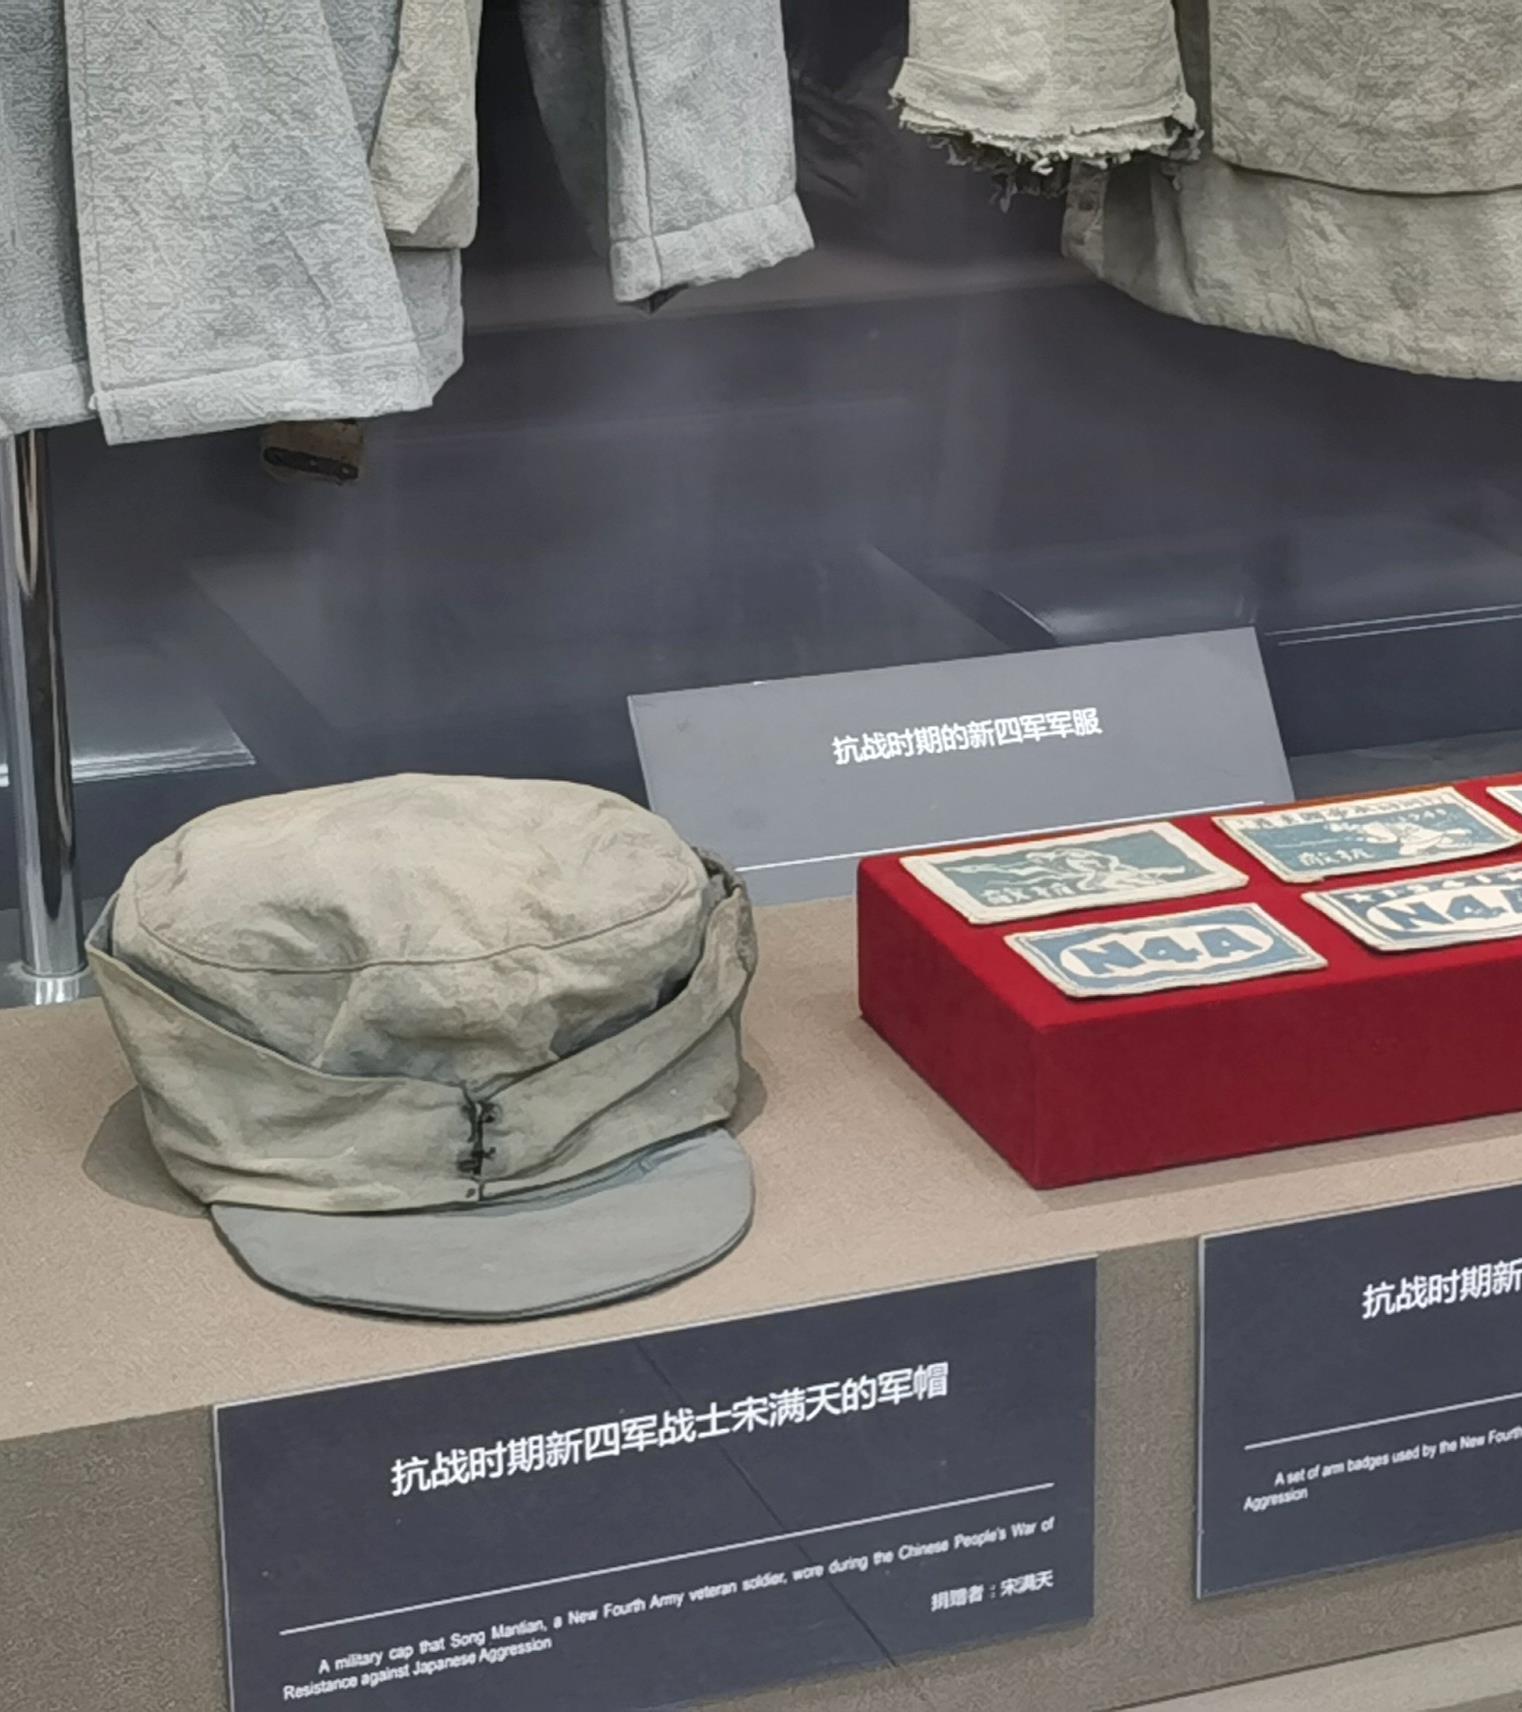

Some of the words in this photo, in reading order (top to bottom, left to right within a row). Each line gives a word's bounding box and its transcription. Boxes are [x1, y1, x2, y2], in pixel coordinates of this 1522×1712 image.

[832, 708, 1102, 764] 抗战时期的新四军军服
[1068, 927, 1260, 976] N4A
[391, 1362, 948, 1497] 抗战时期新四军战士宋满天的军帽
[1275, 1472, 1285, 1486] A
[1287, 1469, 1305, 1484] set
[1307, 1464, 1320, 1480] of
[1322, 1463, 1344, 1477] arm
[1347, 1454, 1389, 1472] badges
[1392, 1445, 1419, 1463] used
[1422, 1444, 1437, 1459] by
[1439, 1440, 1457, 1454] the
[1460, 1436, 1485, 1449] New
[1244, 1488, 1308, 1511] Aggression
[319, 1659, 330, 1674] A
[335, 1652, 383, 1670] military
[389, 1645, 414, 1660] cap
[419, 1637, 445, 1654] that
[450, 1631, 485, 1649] Song
[553, 1616, 562, 1628] a
[568, 1610, 598, 1624] New
[603, 1598, 646, 1618] Fourth
[649, 1593, 684, 1609] Army
[689, 1582, 737, 1601] veteran
[792, 1565, 824, 1581] wore
[828, 1556, 868, 1574] during
[873, 1551, 894, 1565] the
[898, 1540, 949, 1560] Chinese
[954, 1528, 1006, 1549] People's
[1011, 1523, 1036, 1537] War
[1041, 1517, 1054, 1532] of
[283, 1676, 358, 1700] Resistance
[361, 1664, 410, 1687] against
[412, 1652, 476, 1675] Japanese
[479, 1638, 552, 1663] Aggression
